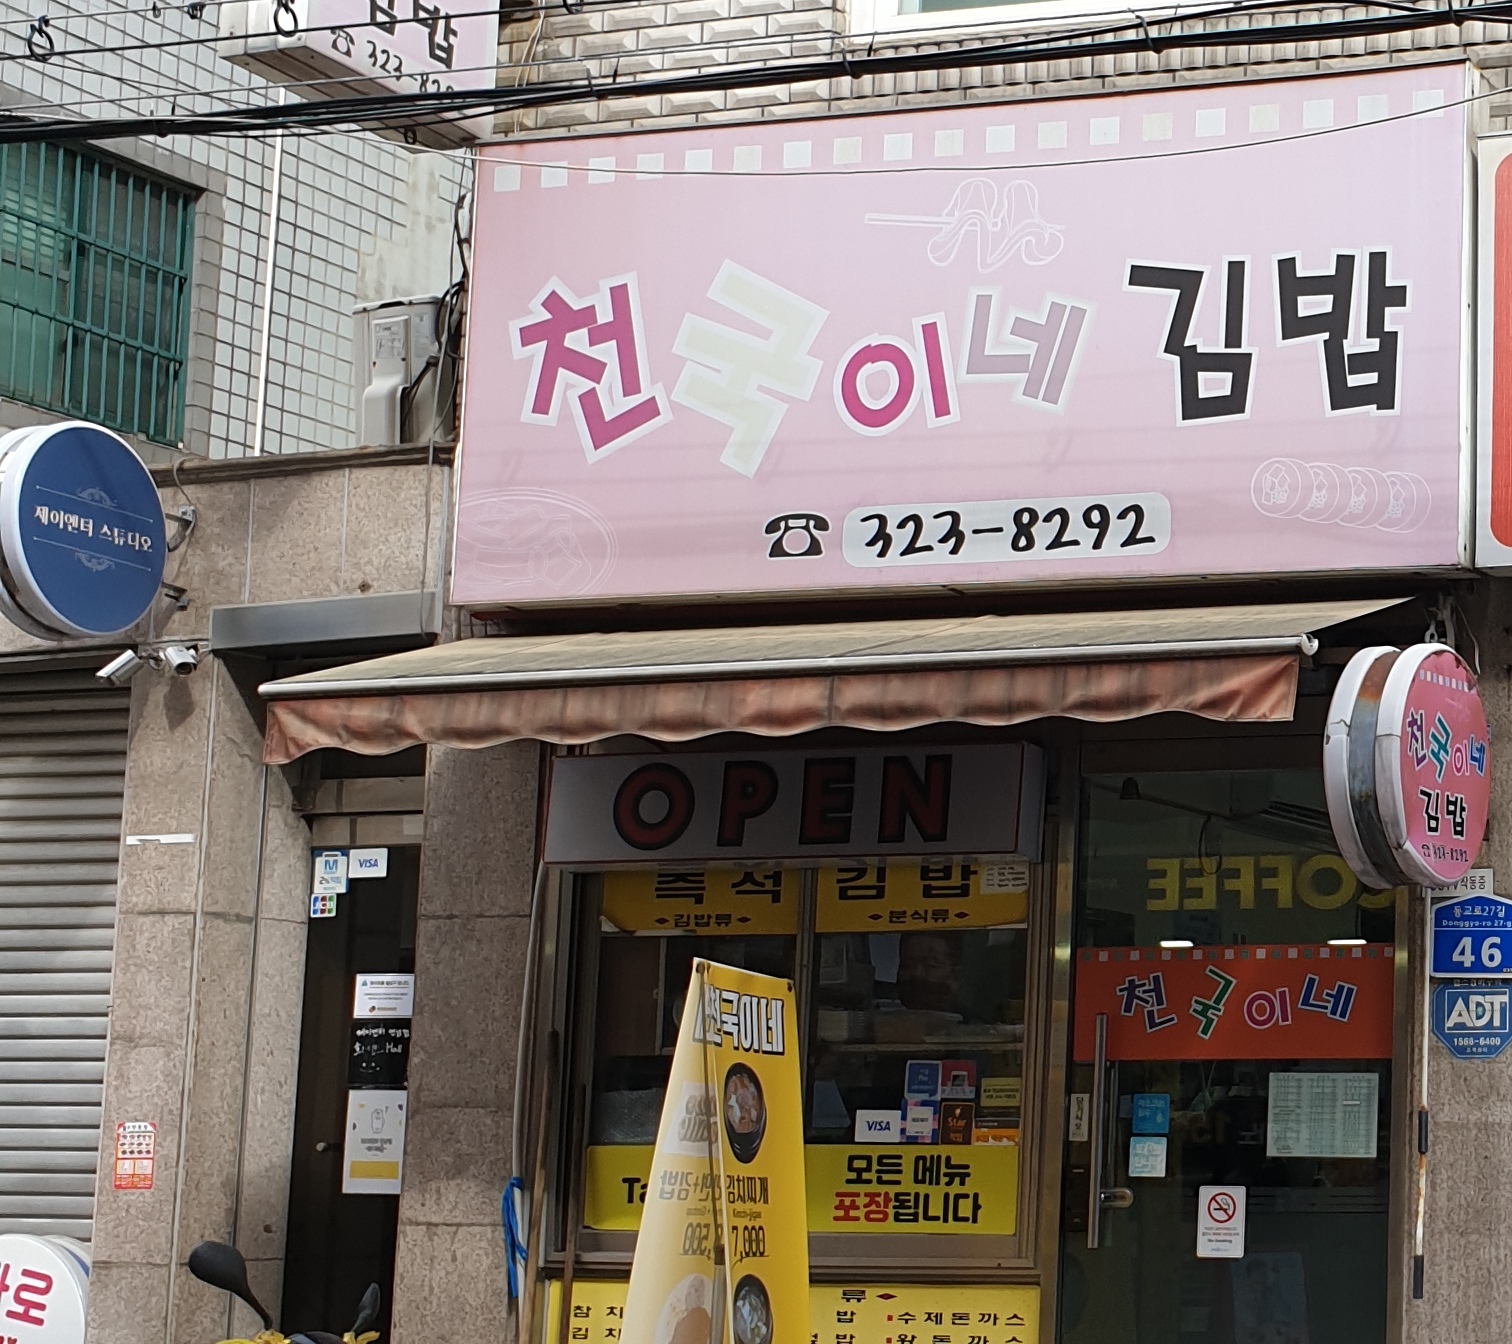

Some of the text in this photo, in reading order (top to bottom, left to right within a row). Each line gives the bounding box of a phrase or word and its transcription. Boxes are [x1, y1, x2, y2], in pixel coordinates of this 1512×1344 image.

[367, 40, 455, 93] 323-82
[510, 248, 1411, 474] 천국이네 김밥
[98, 523, 154, 553] 스튜디오
[860, 502, 1157, 559] 323-8292
[1406, 706, 1487, 783] 천국이네
[612, 753, 953, 851] OPEN
[1417, 786, 1469, 841] 김밥
[357, 858, 379, 869] VISA
[835, 860, 978, 901] 김밥
[672, 913, 733, 928] 김밥류
[887, 909, 950, 925] 분식류
[1452, 905, 1506, 918] 동교로27길
[1451, 935, 1503, 968] 46
[1115, 964, 1359, 1041] 천국이네
[1445, 993, 1508, 1029] ADT
[866, 1120, 891, 1132] VISA
[844, 1153, 972, 1188] 모든 메뉴
[621, 1176, 648, 1204] Ta
[726, 1174, 769, 1205] 김치찌개
[831, 1191, 983, 1225] 포장됩니다
[731, 1225, 767, 1260] 7,000
[896, 1311, 1026, 1327] 수제돈까스
